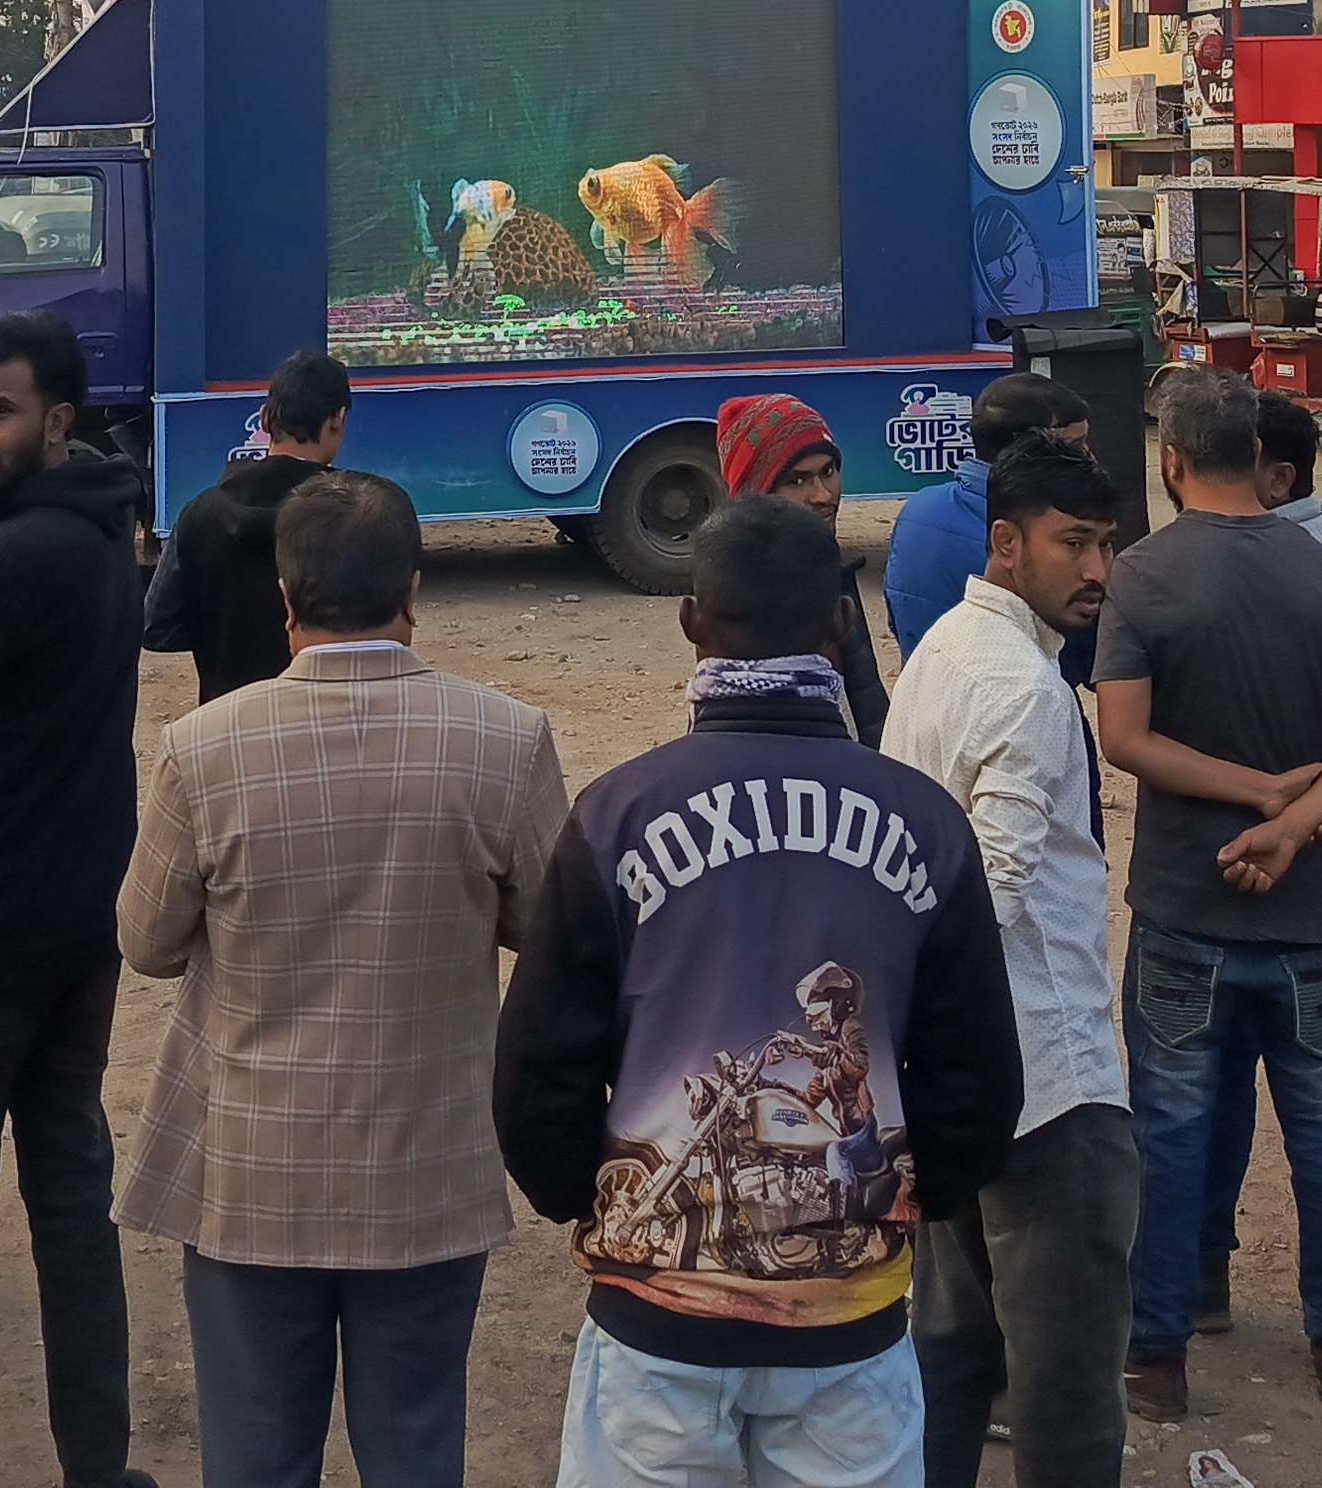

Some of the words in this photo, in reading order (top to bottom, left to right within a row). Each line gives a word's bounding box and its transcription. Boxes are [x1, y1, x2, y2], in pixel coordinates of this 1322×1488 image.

[1014, 131, 1038, 142] নির্বাচন
[992, 144, 1019, 155] দেশের
[1022, 141, 1039, 154] চাবি
[992, 155, 1020, 166] আপনার
[531, 457, 557, 468] দেশের
[560, 455, 577, 466] চাবি
